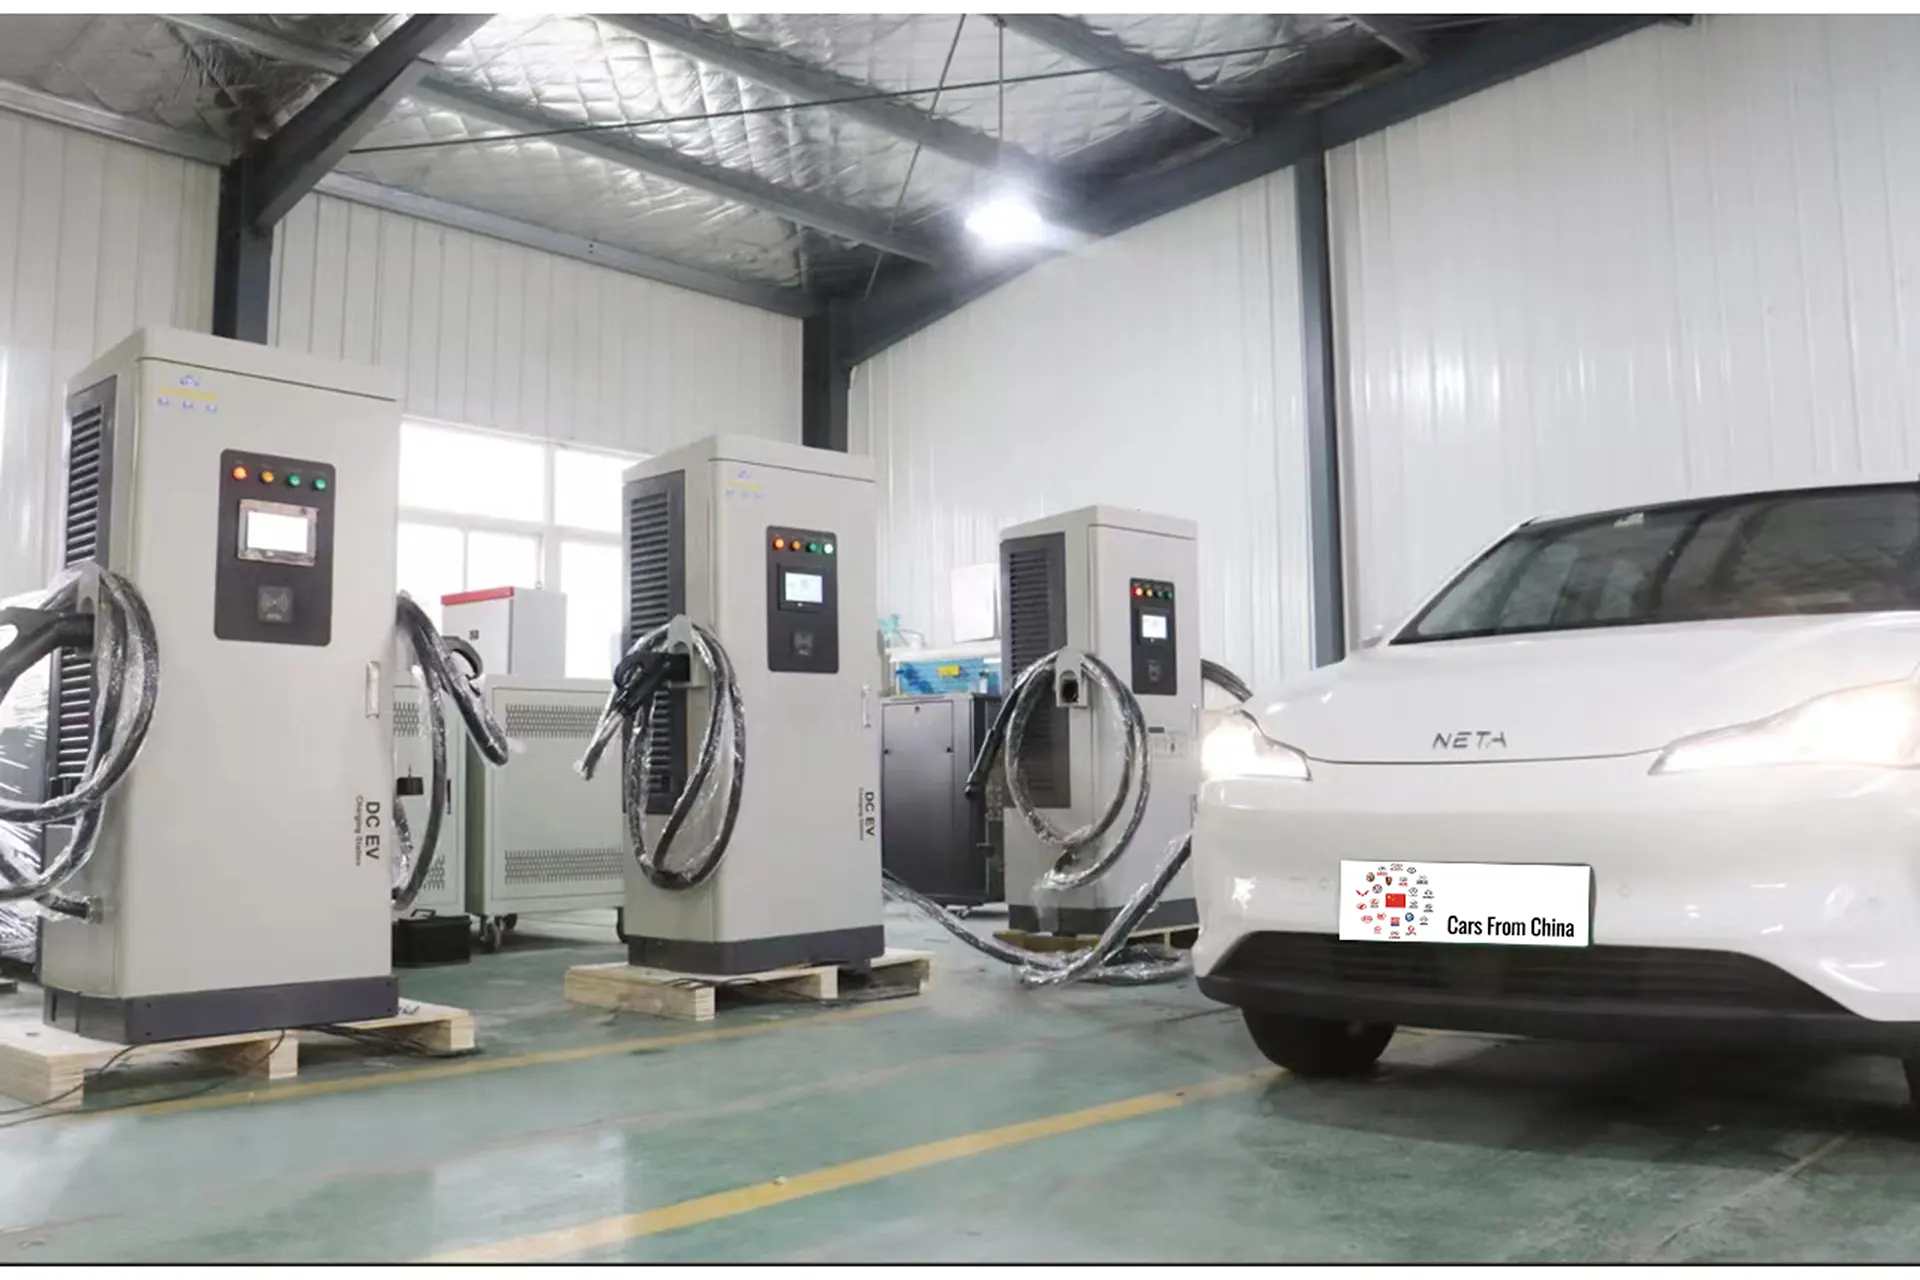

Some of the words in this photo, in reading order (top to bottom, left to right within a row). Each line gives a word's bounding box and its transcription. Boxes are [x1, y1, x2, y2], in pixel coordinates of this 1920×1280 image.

[1432, 730, 1508, 749] NETA
[865, 791, 875, 812] DC
[366, 801, 381, 828] DC
[366, 835, 380, 860] EV
